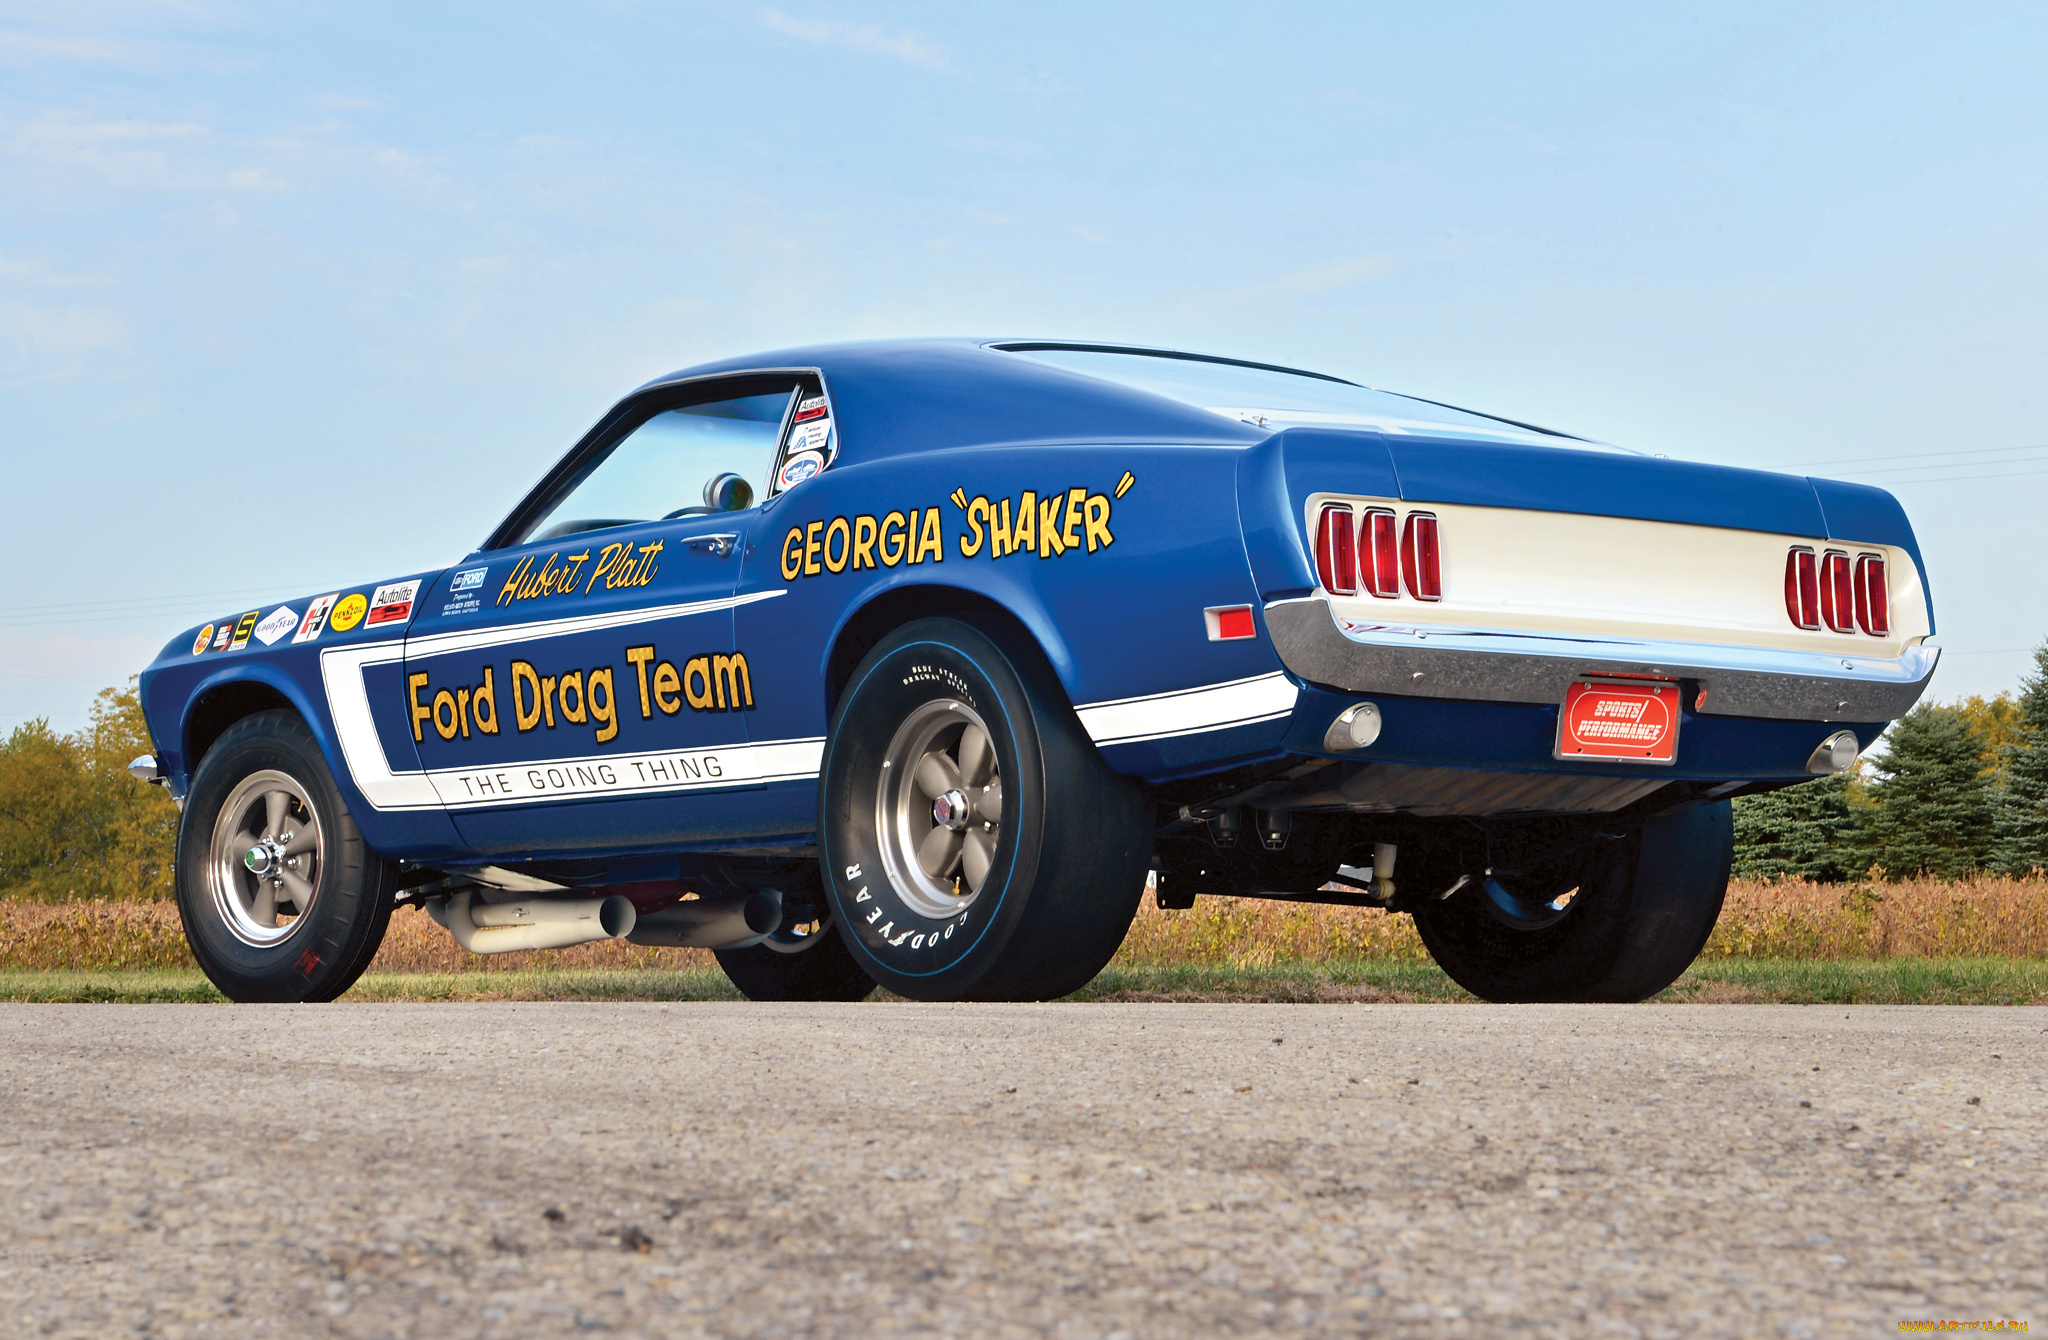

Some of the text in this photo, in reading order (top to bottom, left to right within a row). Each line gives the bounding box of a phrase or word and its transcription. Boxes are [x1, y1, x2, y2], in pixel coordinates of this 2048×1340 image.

[780, 469, 1136, 582] GEORGIA "SHAKER"
[463, 571, 484, 585] FORD
[496, 538, 664, 608] Hubert Platt
[376, 586, 413, 606] Autolite
[334, 605, 363, 620] PENNZOIL
[912, 665, 932, 674] BLUE
[408, 643, 757, 747] Ford Drag Team
[1577, 720, 1662, 741] PERFORMANCE
[459, 755, 724, 797] THE GOING THING
[845, 862, 968, 950] GOODYEAR
